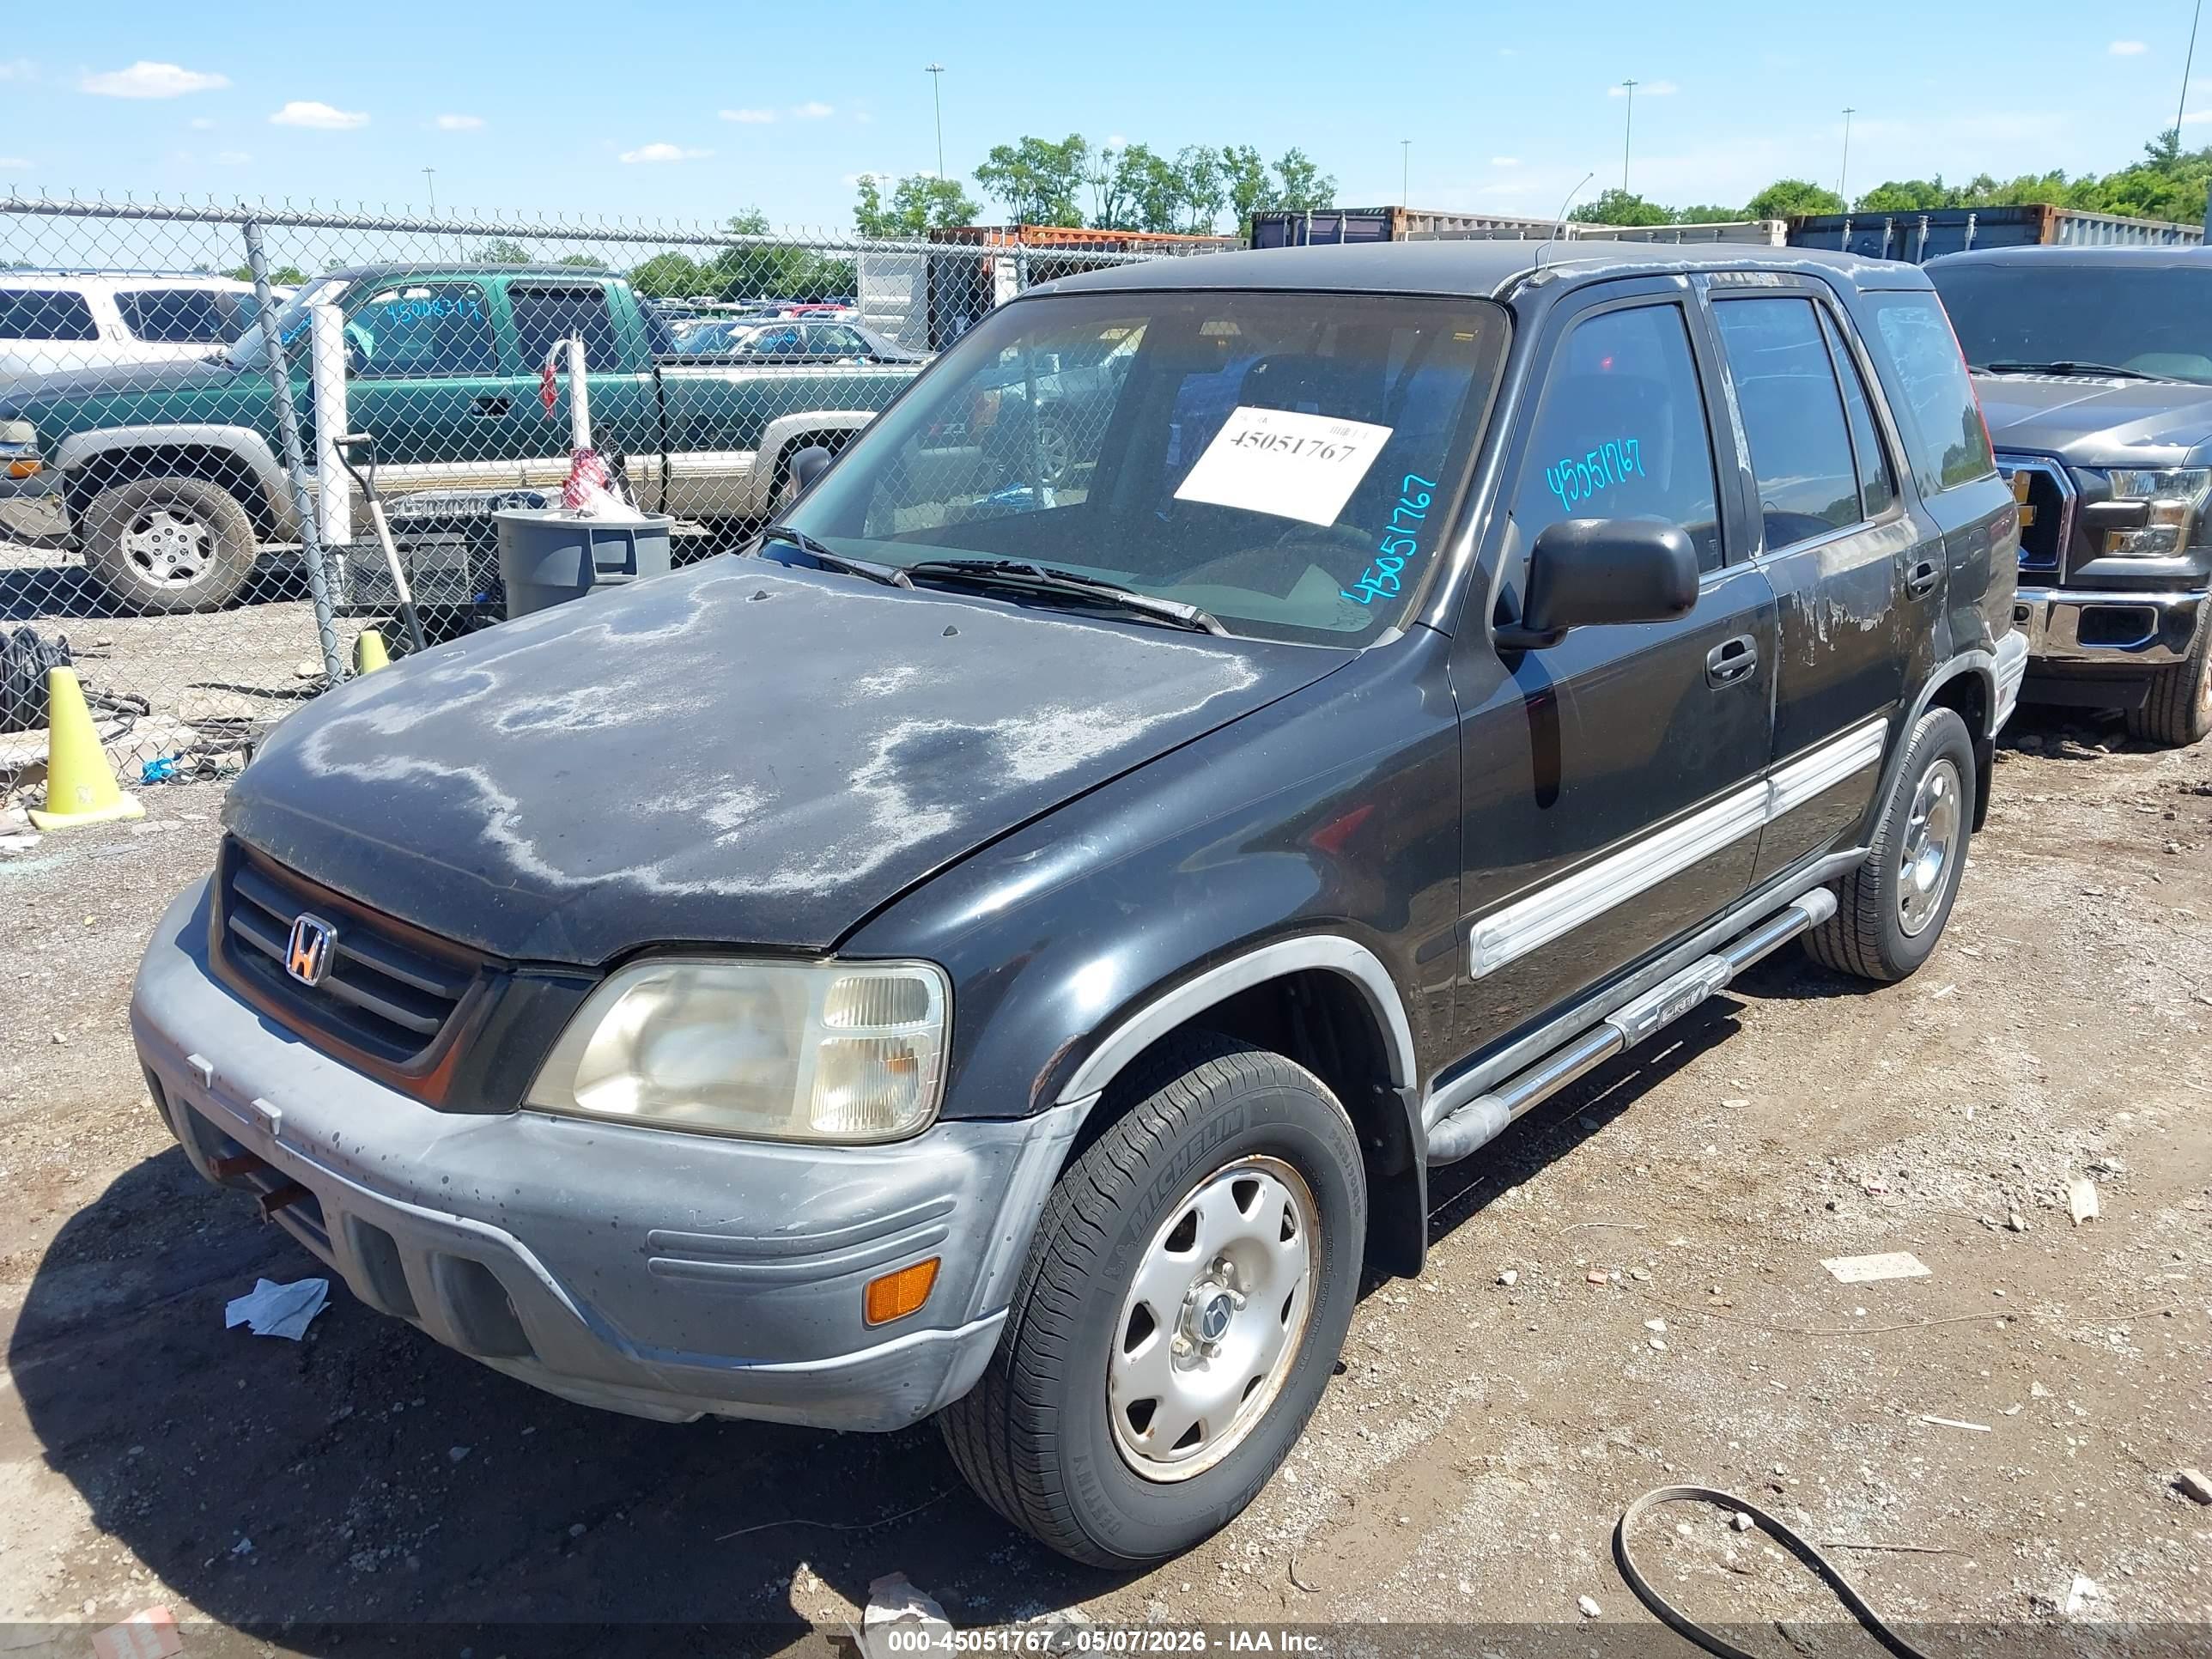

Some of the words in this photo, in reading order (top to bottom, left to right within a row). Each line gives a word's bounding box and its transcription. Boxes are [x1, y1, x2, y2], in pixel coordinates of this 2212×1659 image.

[1231, 430, 1356, 462] 45051767
[1340, 473, 1437, 605] 45051767
[1127, 1104, 1244, 1237] MICHELIN
[1073, 1455, 1121, 1537] DESTINY
